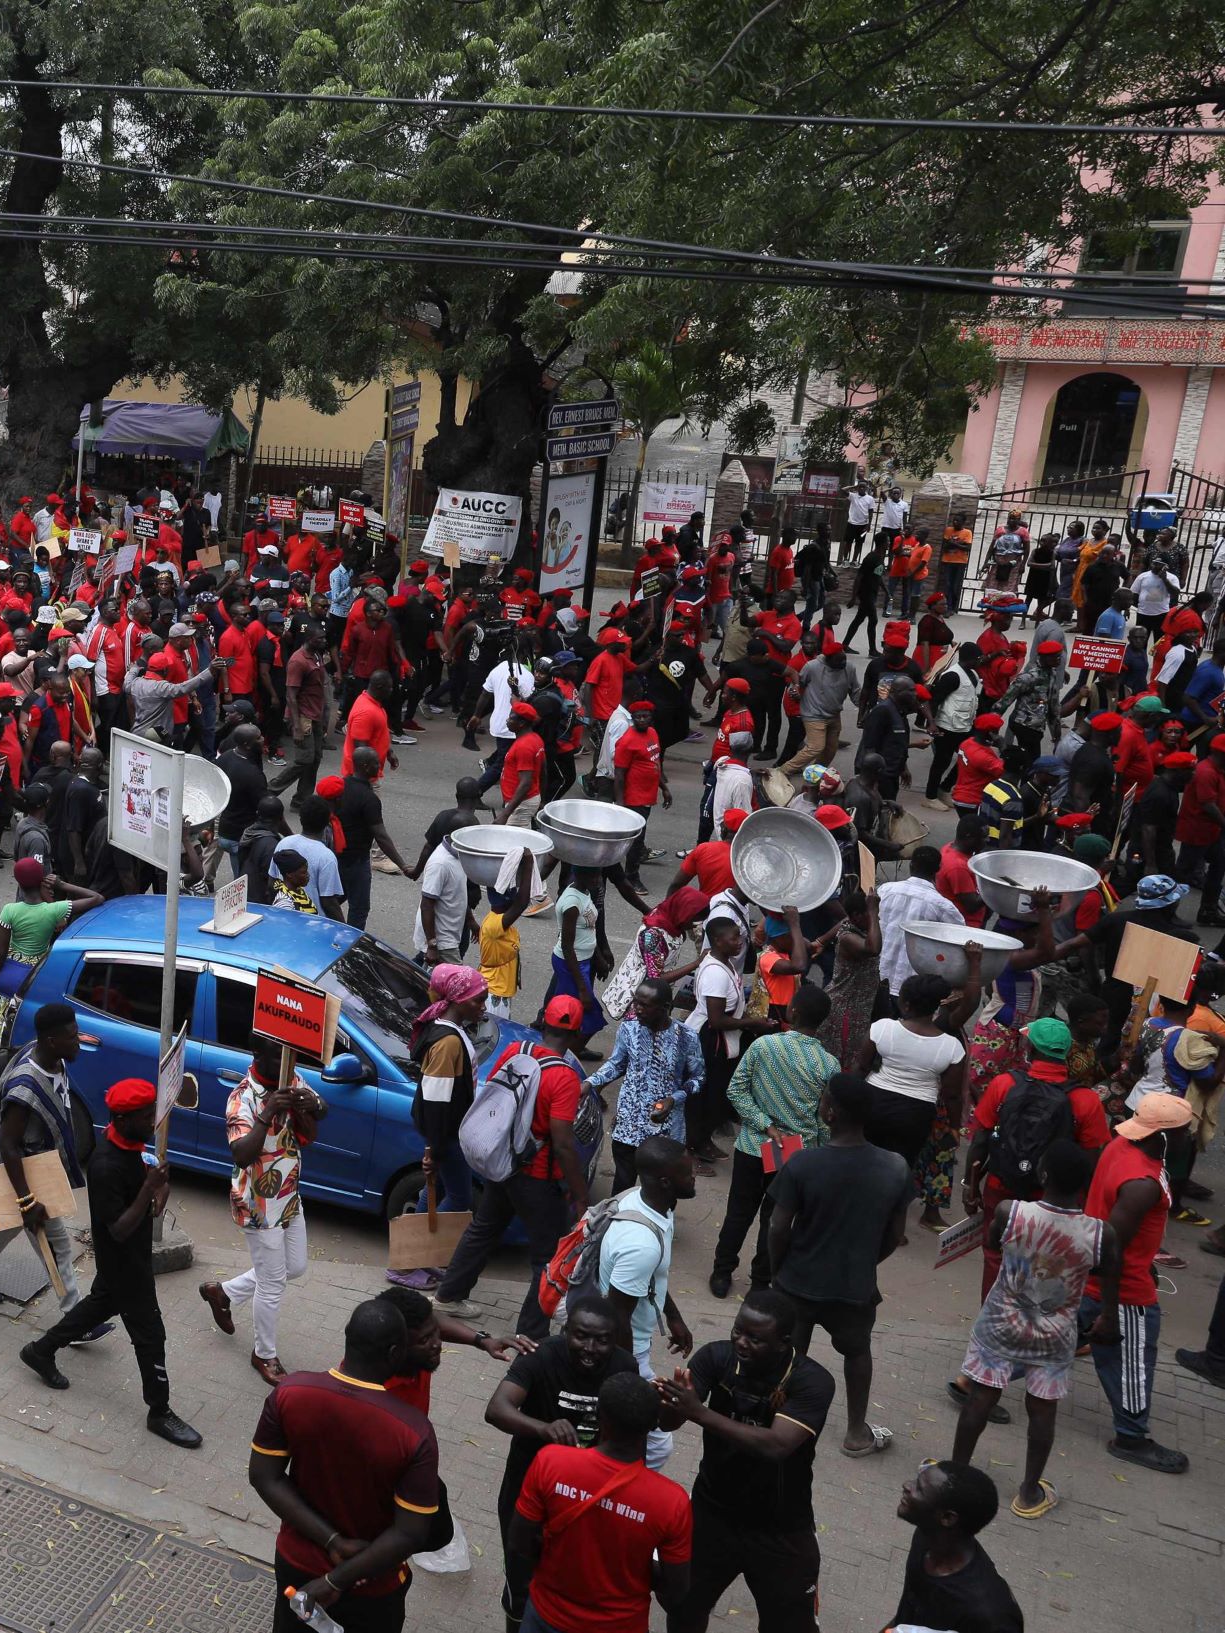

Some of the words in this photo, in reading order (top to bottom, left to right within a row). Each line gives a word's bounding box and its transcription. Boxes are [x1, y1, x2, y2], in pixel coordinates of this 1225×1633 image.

[551, 411, 564, 425] REV.
[564, 409, 585, 424] ERNEST
[585, 407, 603, 421] BRUCE
[1059, 423, 1077, 431] Pull
[568, 440, 587, 455] BASIC
[587, 437, 610, 452] SCHOOL
[342, 505, 360, 513] ENOUGH
[461, 497, 507, 515] AUCC
[343, 515, 361, 523] ENOUGH
[446, 513, 473, 521] ADMISSION
[479, 517, 506, 525] ONGOING
[470, 523, 514, 534] ADMINISTRATION
[1091, 645, 1120, 654] CANNOT
[276, 993, 304, 1013] NANA
[257, 1001, 321, 1033] AKUFRAUDO
[554, 1482, 577, 1499] NDC
[579, 1489, 614, 1512] Yoth
[615, 1502, 646, 1523] Wing
